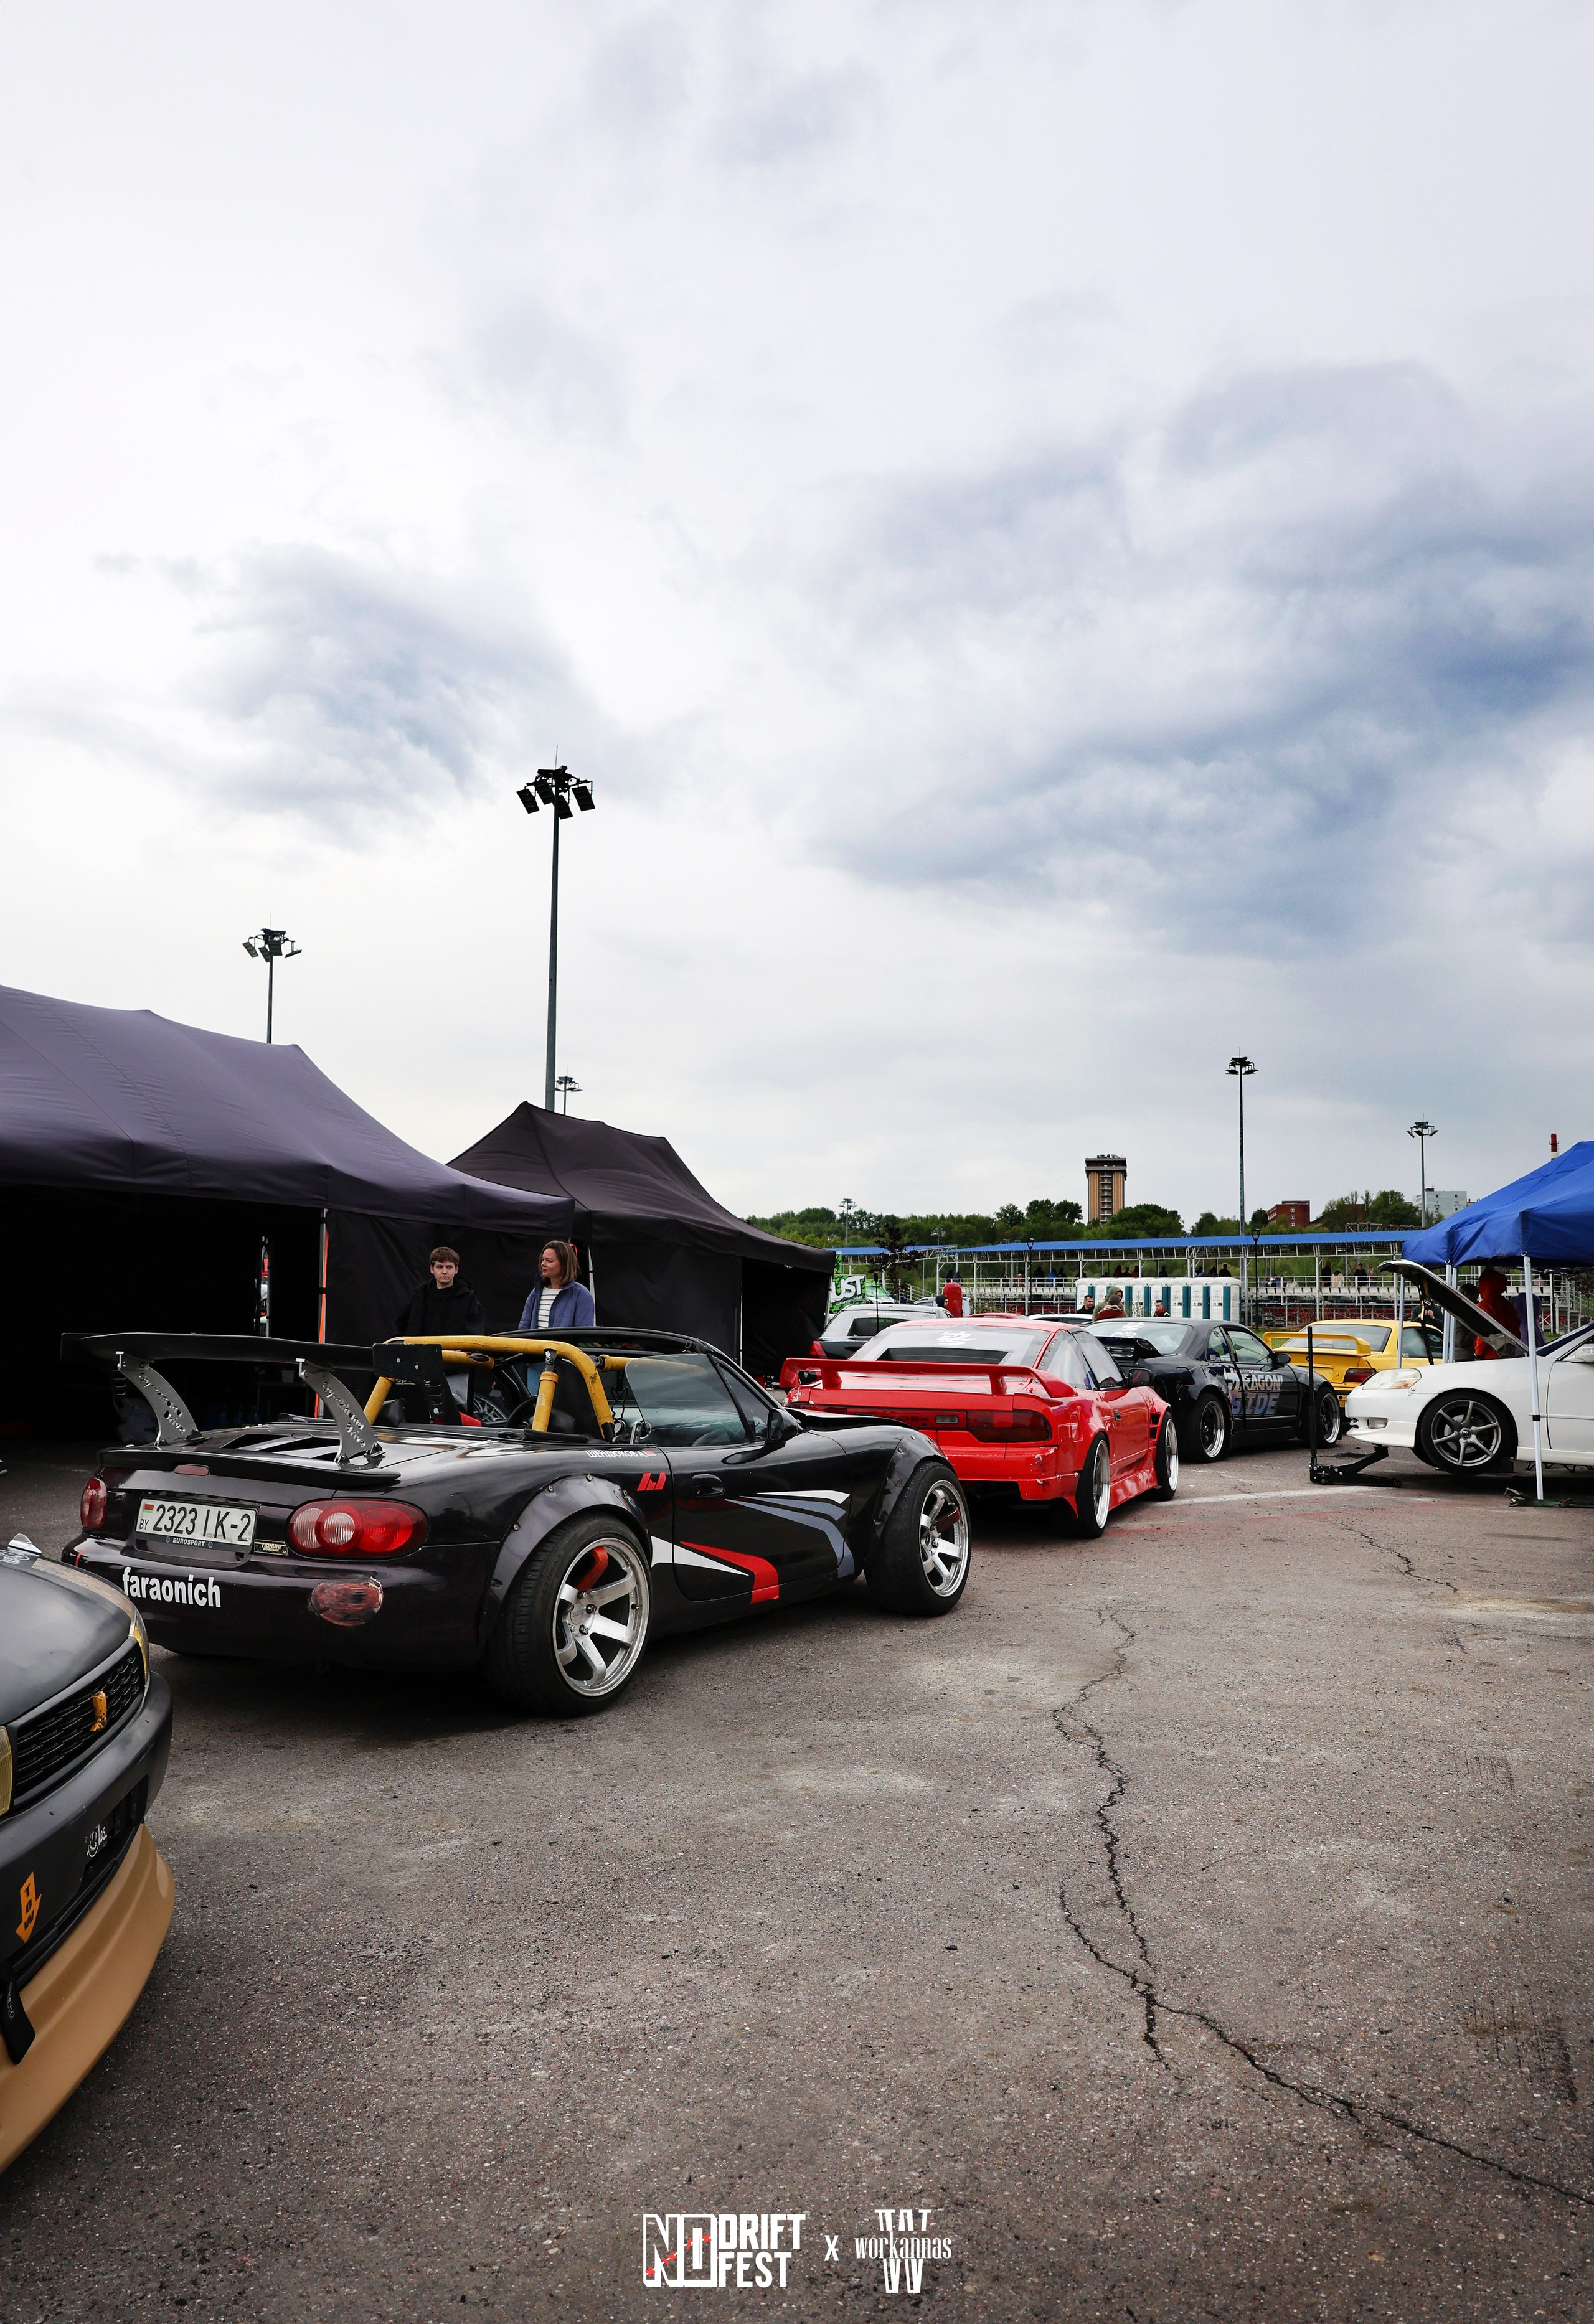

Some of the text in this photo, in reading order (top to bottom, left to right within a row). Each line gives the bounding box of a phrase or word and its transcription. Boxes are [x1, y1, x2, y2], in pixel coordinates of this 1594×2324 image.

[139, 1518, 149, 1530] BY
[153, 1504, 198, 1535] 2323
[172, 1537, 205, 1547] EUROSPORT
[122, 1566, 222, 1608] faraonich
[24, 1883, 34, 1931] TOW
